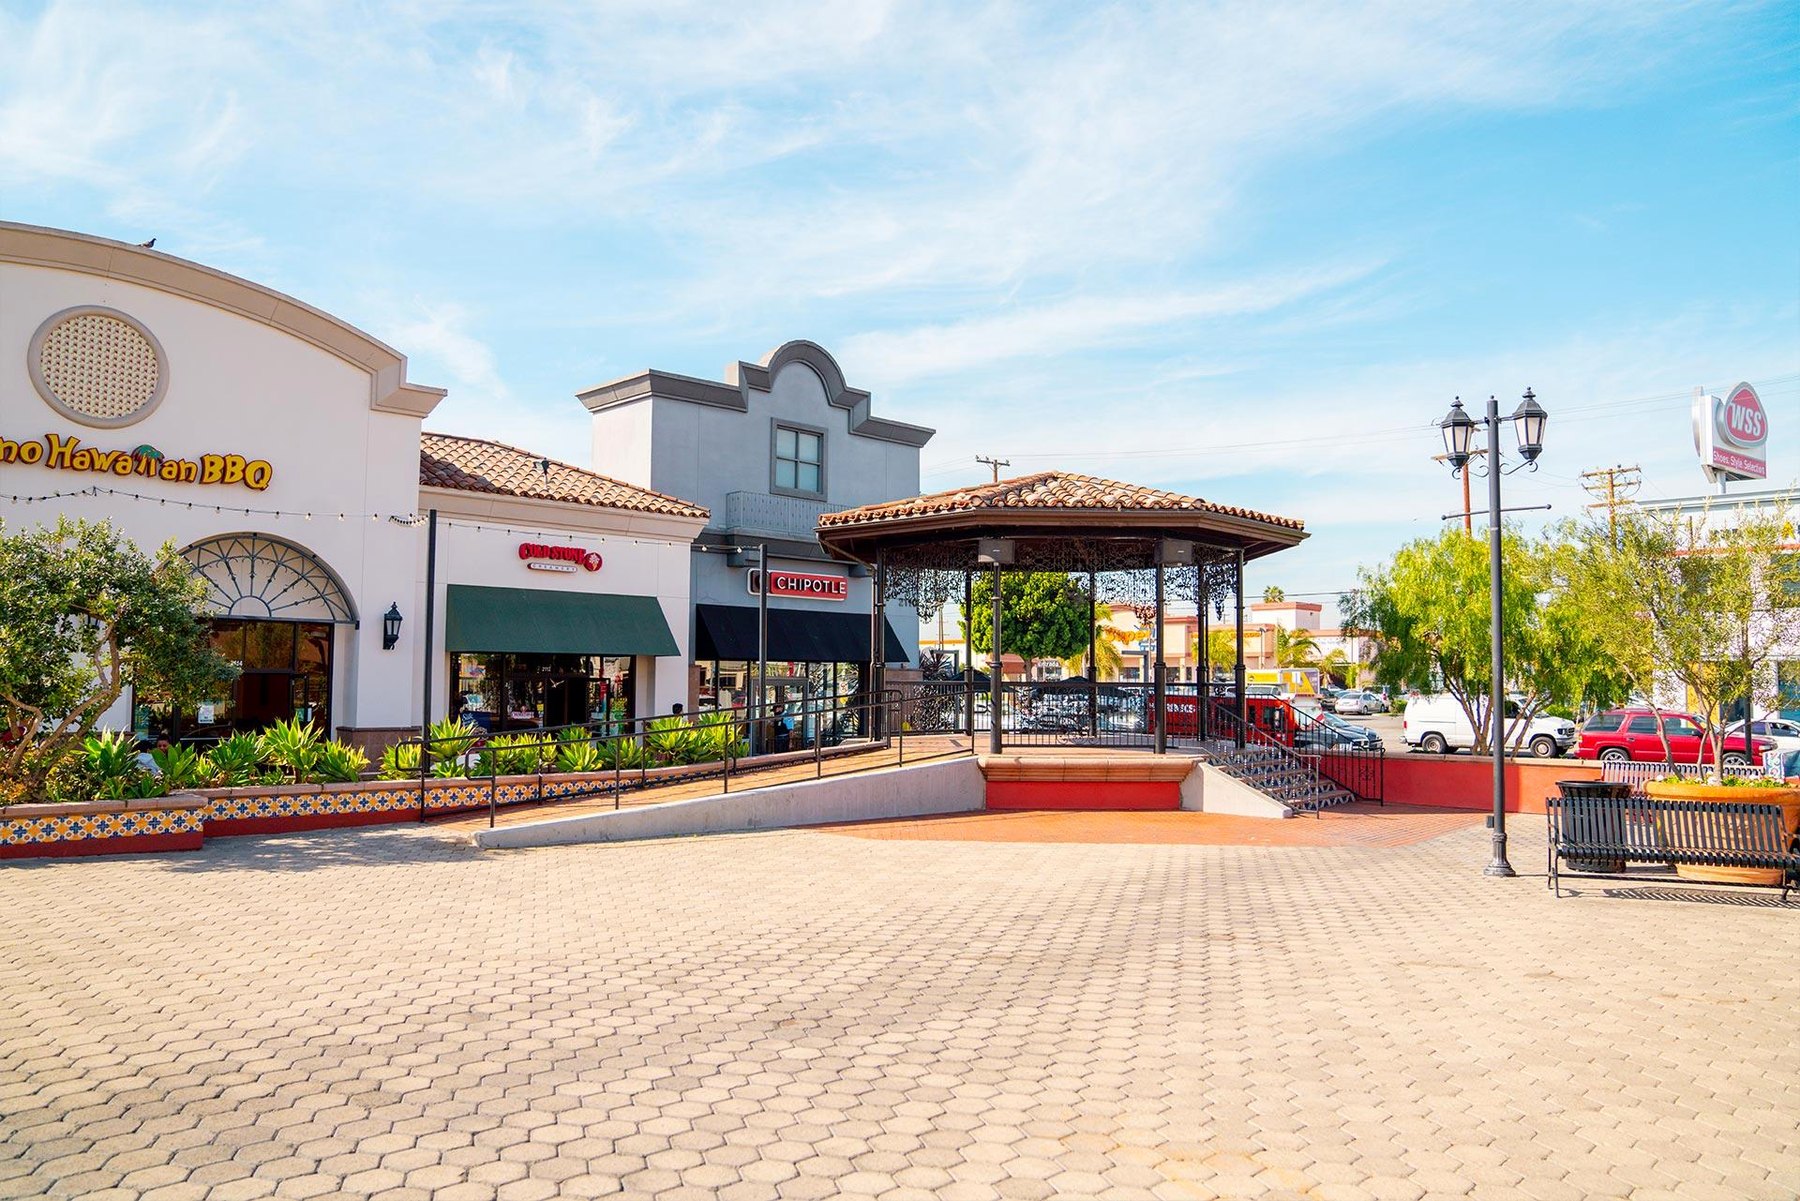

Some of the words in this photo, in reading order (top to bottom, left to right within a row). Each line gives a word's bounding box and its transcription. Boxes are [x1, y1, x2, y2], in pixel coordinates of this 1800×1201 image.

[1729, 401, 1761, 436] WSS
[44, 433, 198, 483] Hawaiian
[199, 453, 272, 491] BBQ
[777, 576, 846, 594] CHIPOTLE
